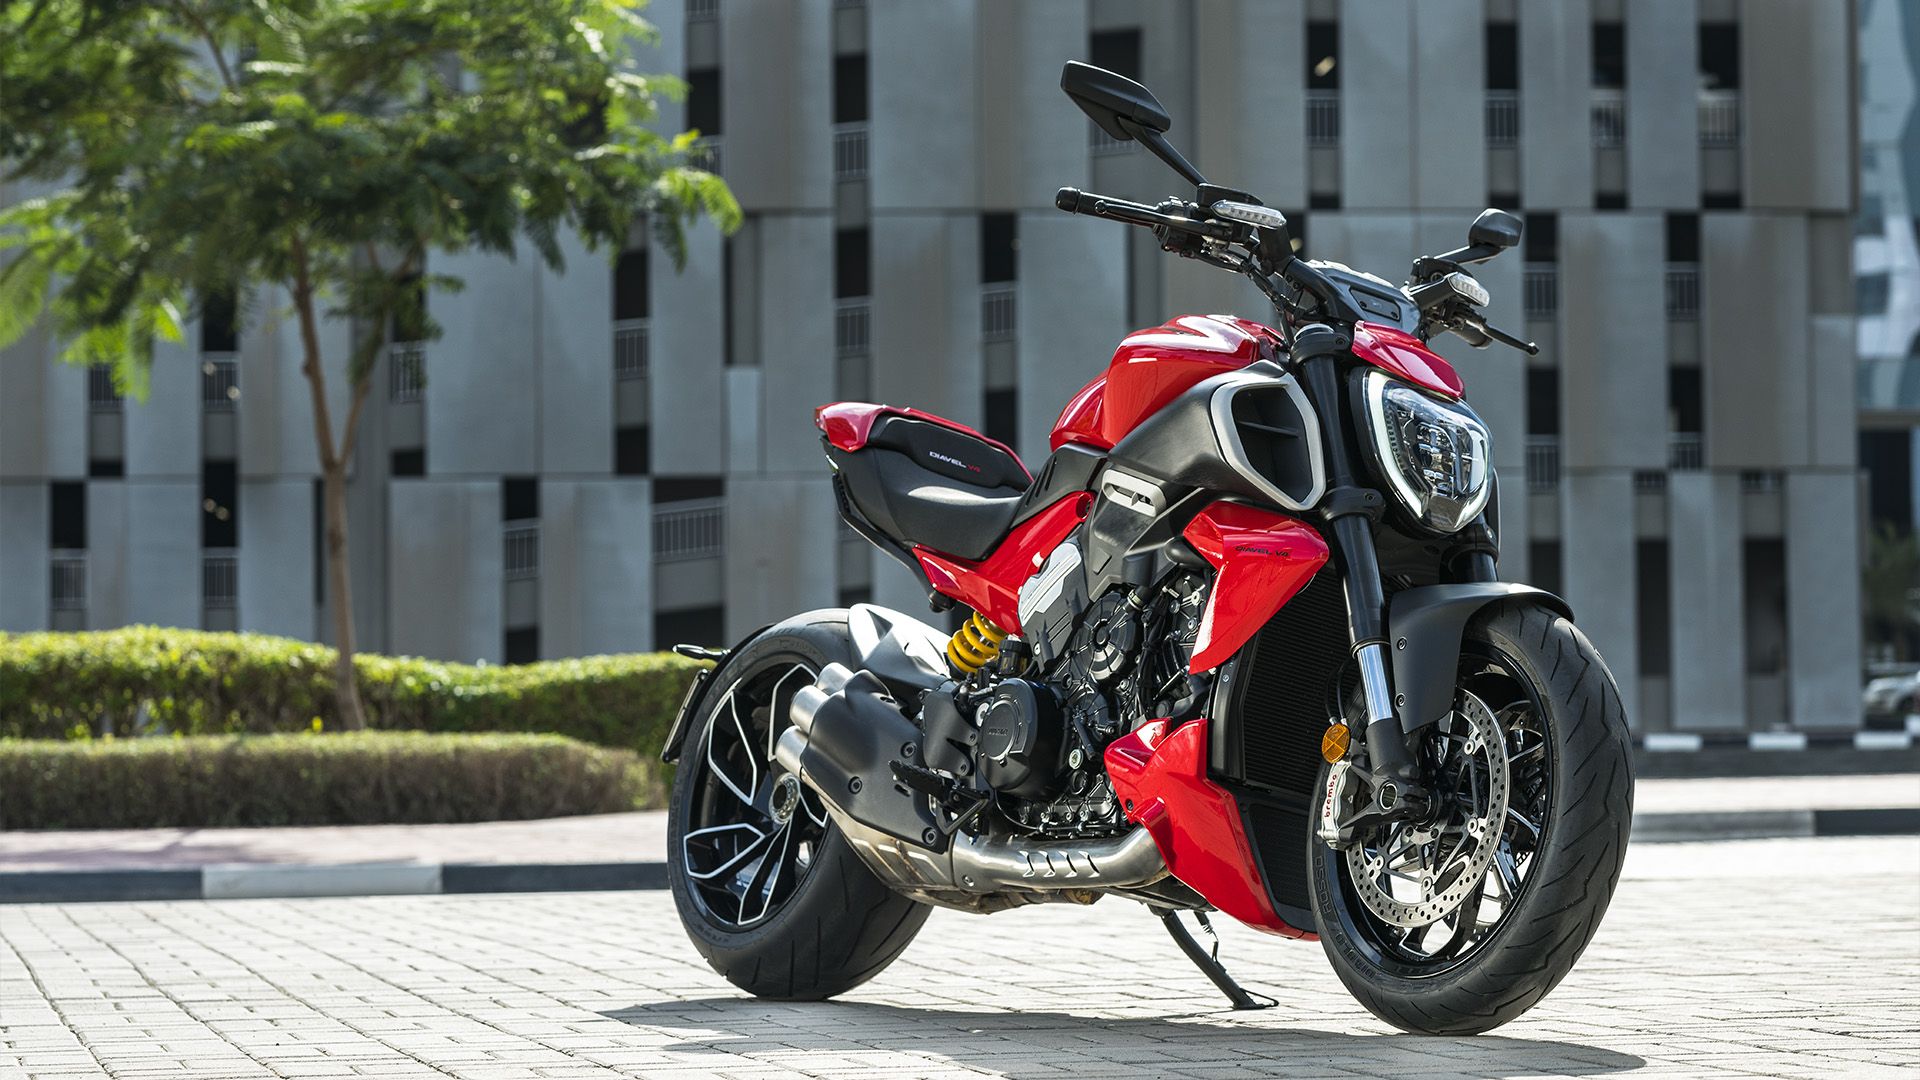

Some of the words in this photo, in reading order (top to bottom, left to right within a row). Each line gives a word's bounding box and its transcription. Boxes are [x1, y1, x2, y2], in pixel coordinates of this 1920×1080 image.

[929, 451, 967, 468] DIAVEL
[1235, 546, 1272, 555] DIAVEL
[1323, 774, 1338, 818] brembo
[1315, 855, 1332, 914] ROSSO
